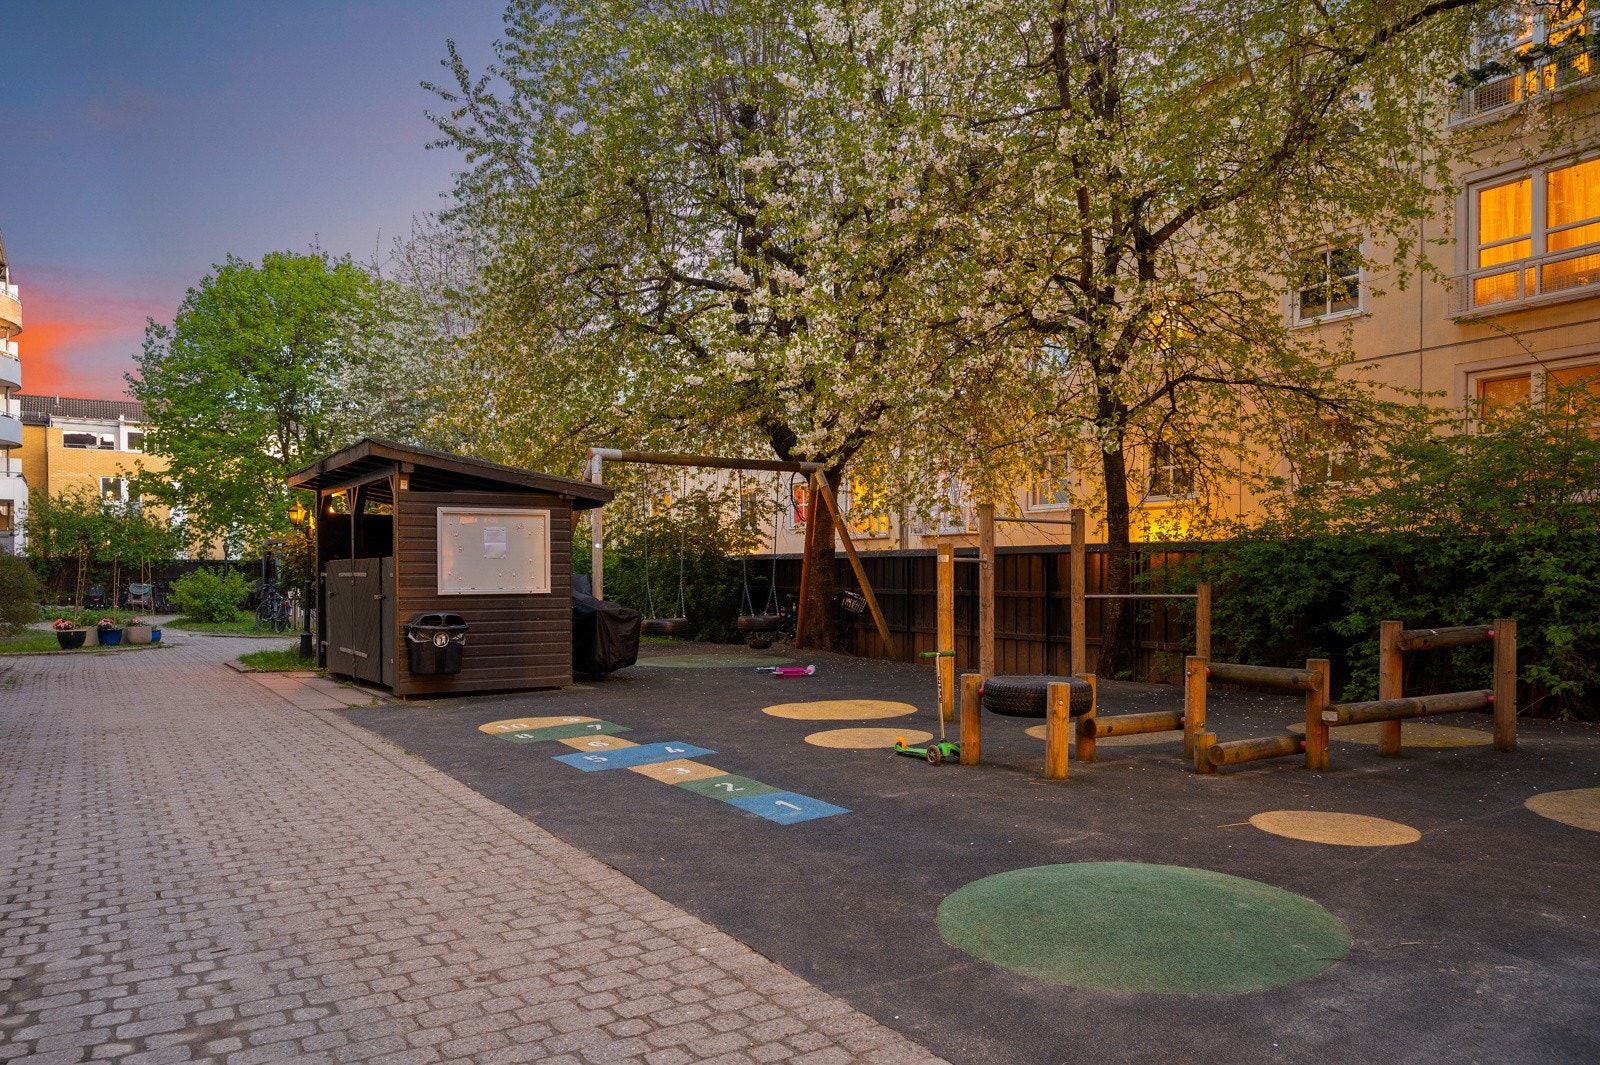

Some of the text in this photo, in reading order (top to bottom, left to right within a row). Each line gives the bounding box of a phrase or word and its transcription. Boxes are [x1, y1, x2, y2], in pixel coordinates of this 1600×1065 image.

[583, 755, 608, 763] 5
[666, 767, 691, 775] 3
[714, 782, 745, 792] 2
[774, 800, 802, 811] 1
